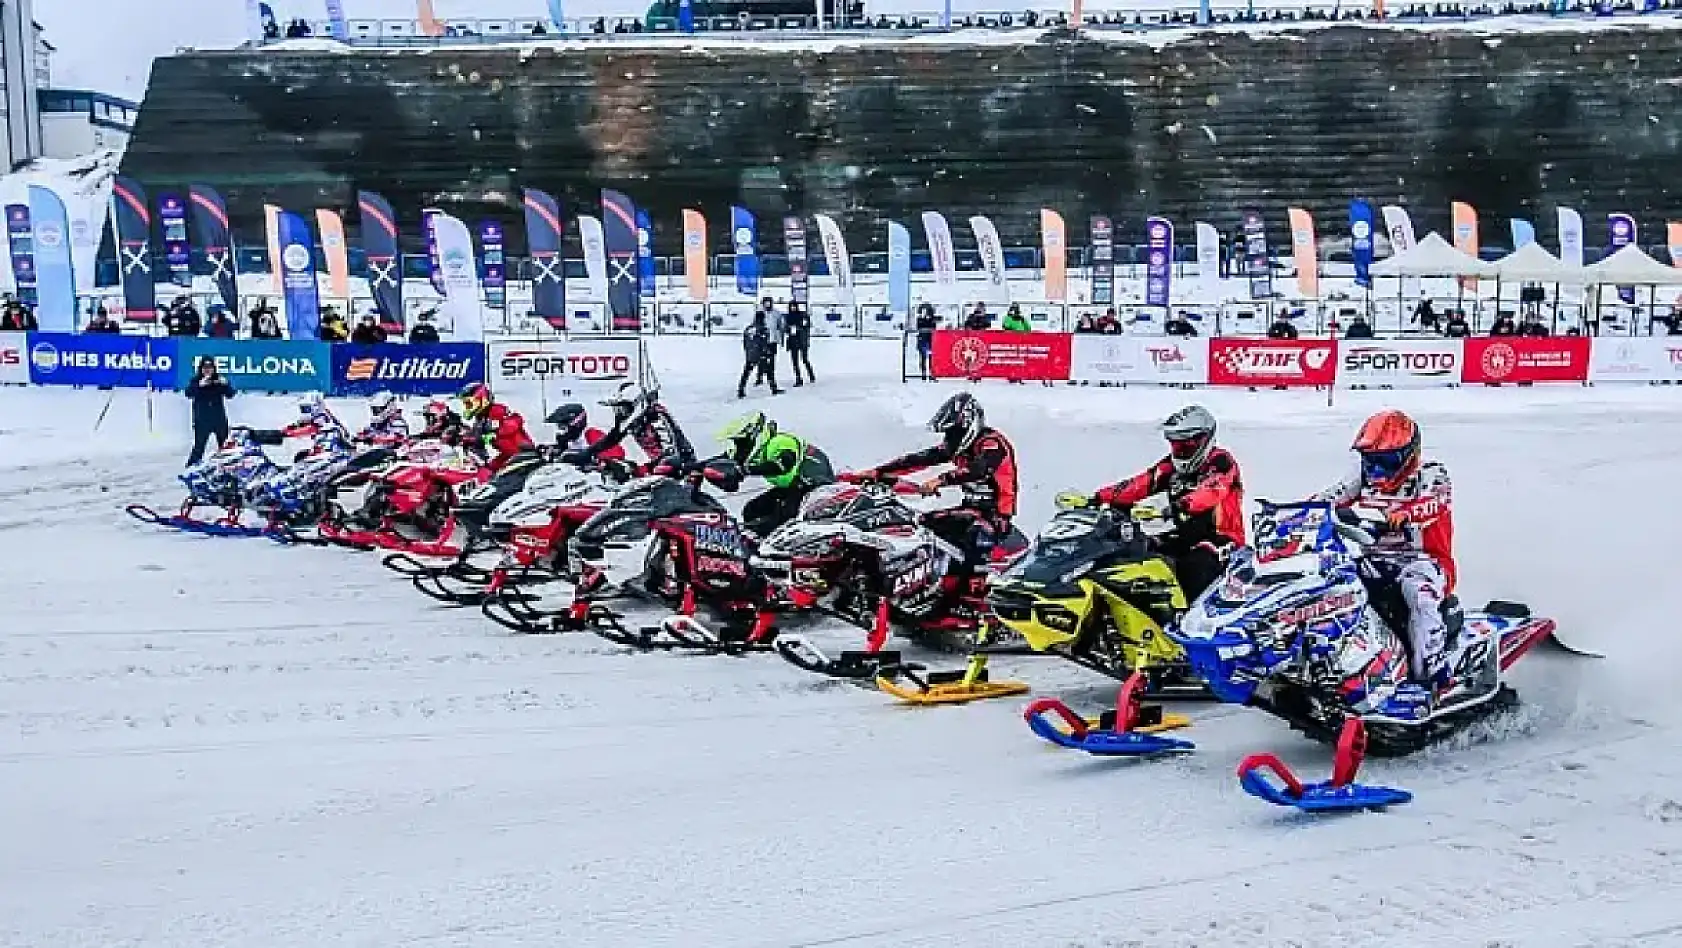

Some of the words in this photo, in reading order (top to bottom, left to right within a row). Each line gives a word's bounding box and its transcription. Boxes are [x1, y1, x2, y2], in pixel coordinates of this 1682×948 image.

[62, 351, 98, 367] HES
[104, 352, 172, 370] KABLO
[1252, 351, 1297, 367] TMF
